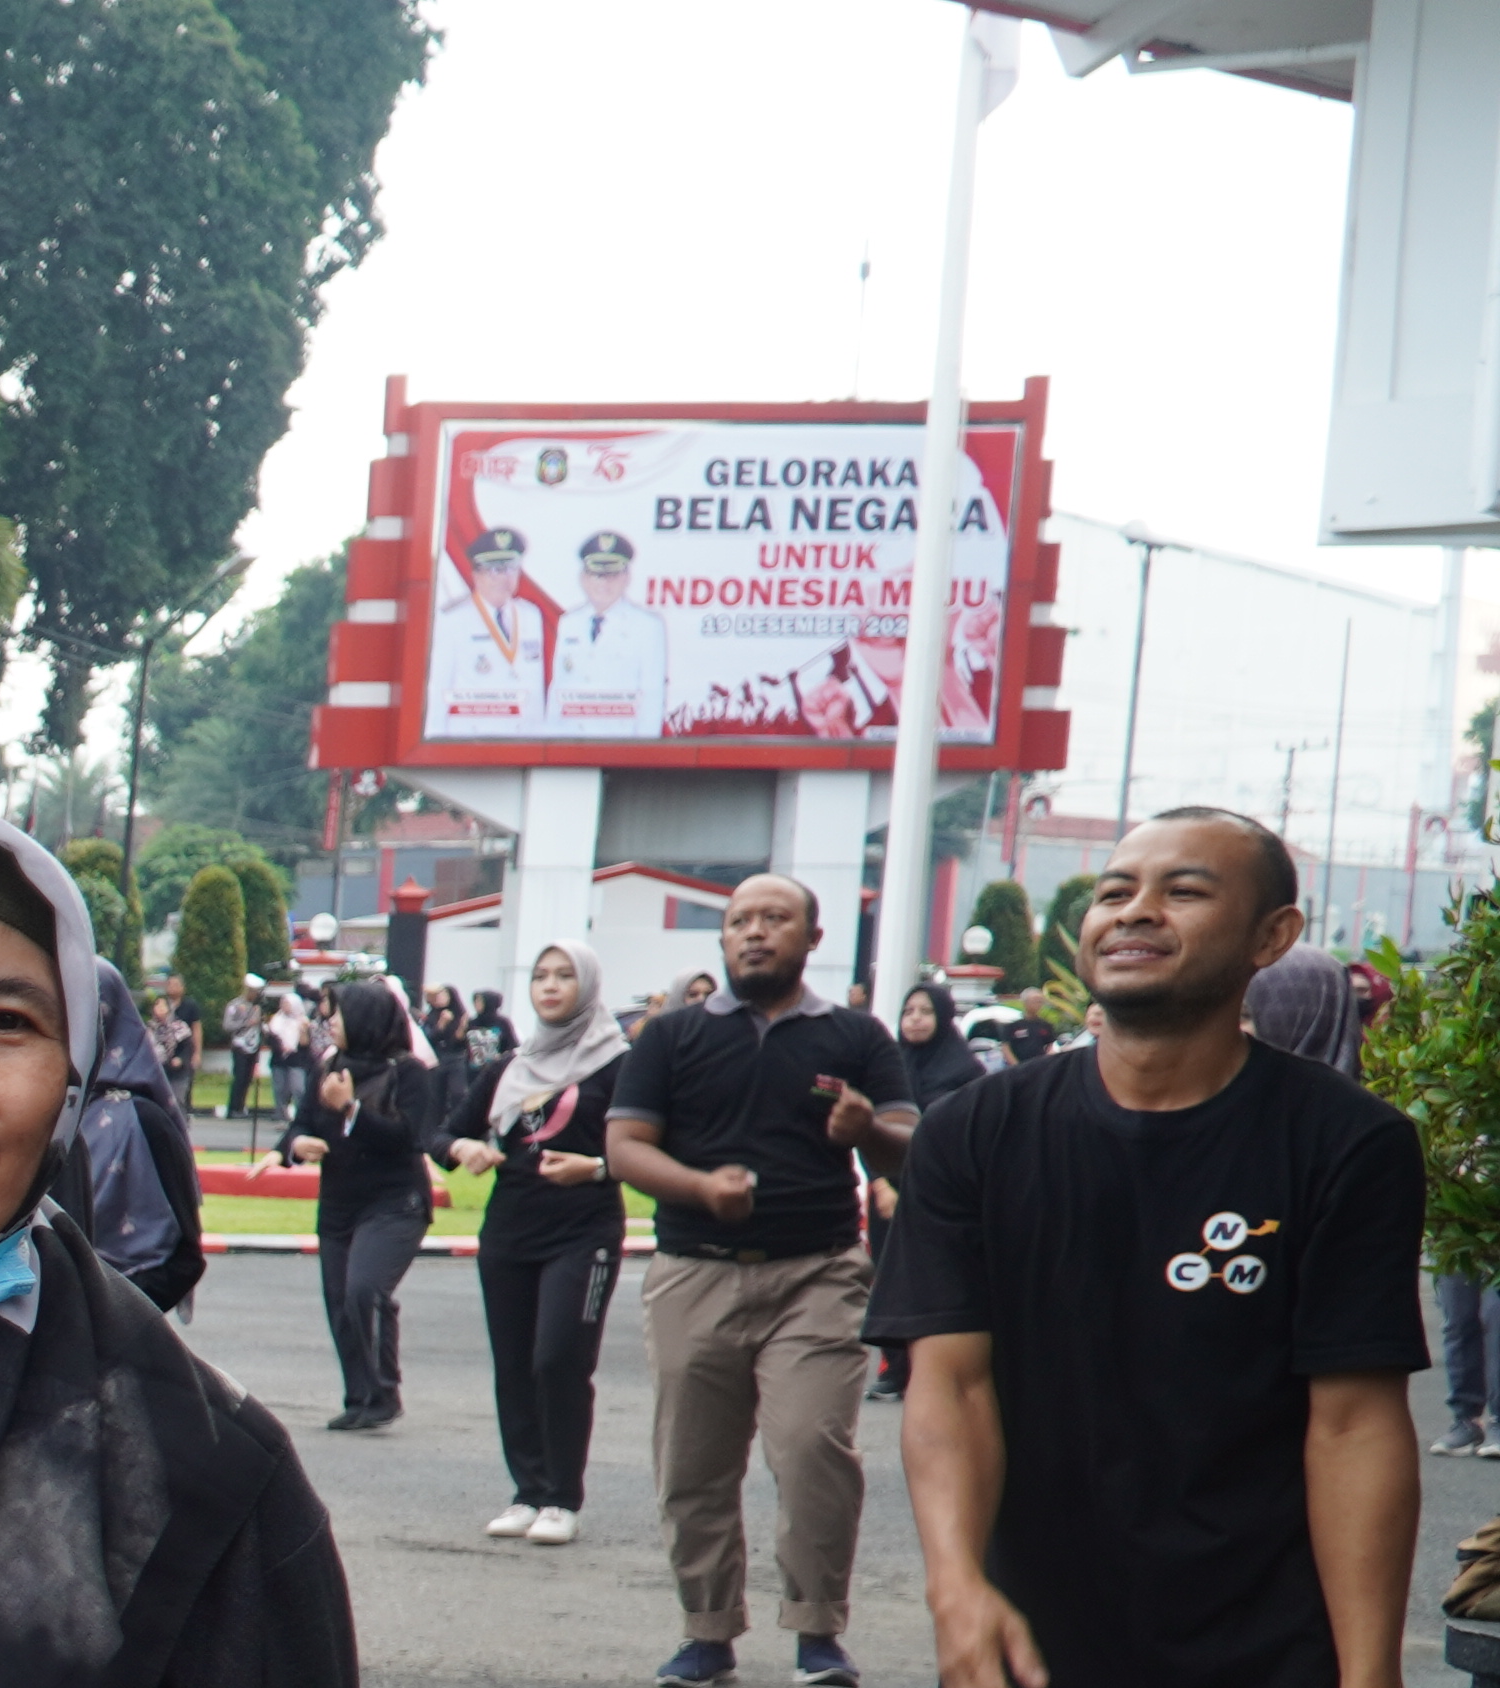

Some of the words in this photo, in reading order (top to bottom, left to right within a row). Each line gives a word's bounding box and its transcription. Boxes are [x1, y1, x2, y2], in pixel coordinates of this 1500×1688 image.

[704, 457, 919, 487] GELORAKA
[653, 496, 773, 531] BELA
[790, 496, 989, 531] NEGAA
[757, 543, 879, 570] UNTUK
[645, 576, 866, 607] INDONESIA
[879, 578, 987, 608] MJU
[734, 613, 859, 636] DESEMBER
[864, 614, 910, 637] 202
[1209, 1221, 1242, 1241] N
[1174, 1262, 1202, 1282] C
[1228, 1264, 1263, 1284] M
